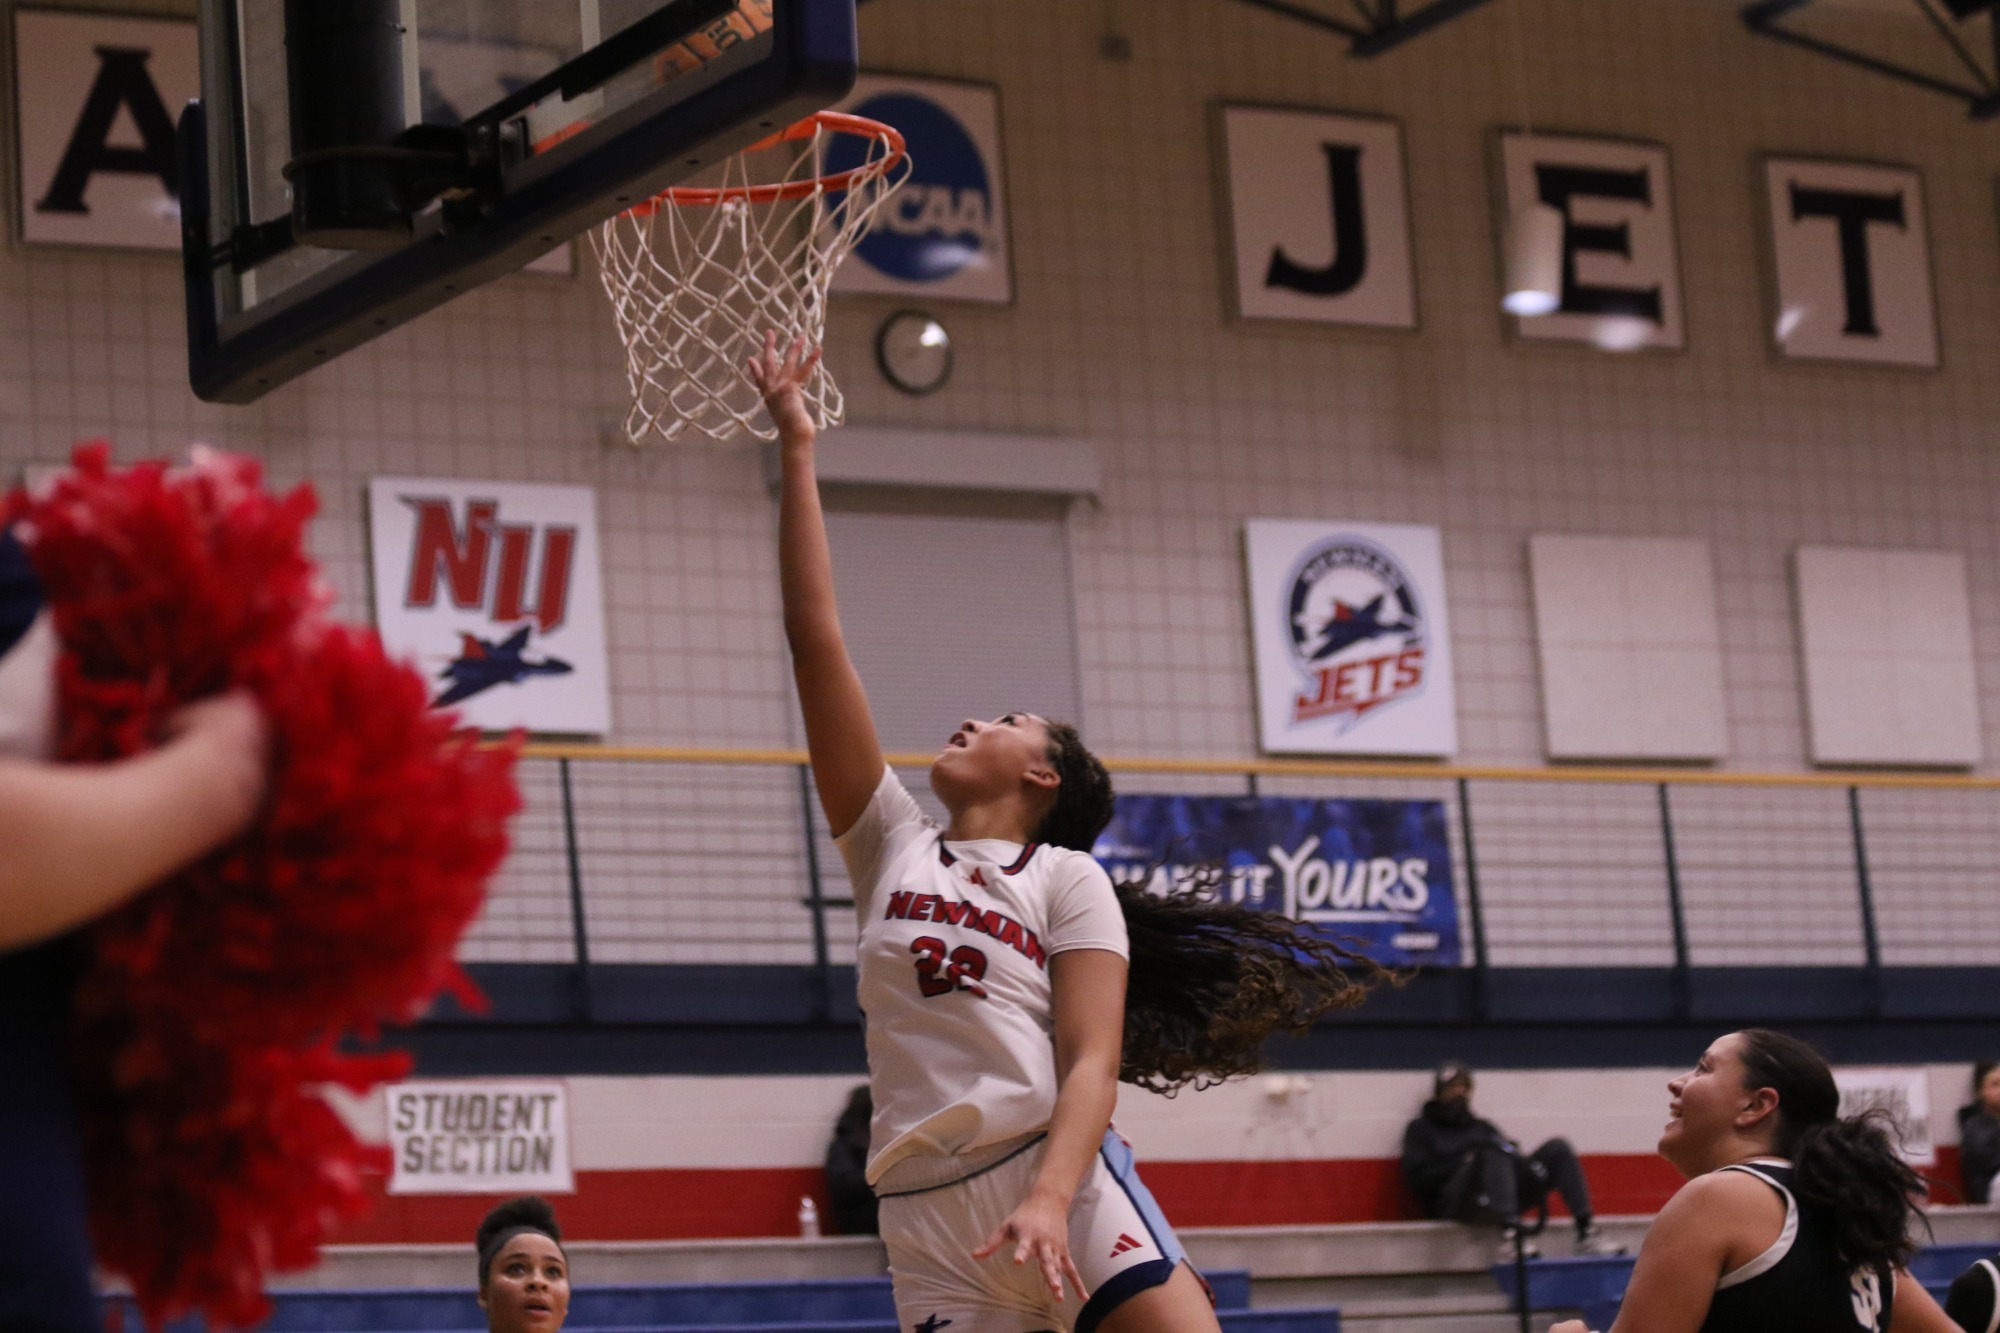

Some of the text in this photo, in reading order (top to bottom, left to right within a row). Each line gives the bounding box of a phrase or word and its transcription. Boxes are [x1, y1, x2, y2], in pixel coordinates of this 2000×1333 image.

[398, 495, 578, 634] NU
[1296, 648, 1425, 706] JETS
[1268, 835, 1428, 920] YOURS
[884, 890, 1047, 970] NEWMAN
[911, 935, 988, 998] 22
[395, 1093, 557, 1132] STUDENT
[402, 1135, 553, 1174] SECTION
